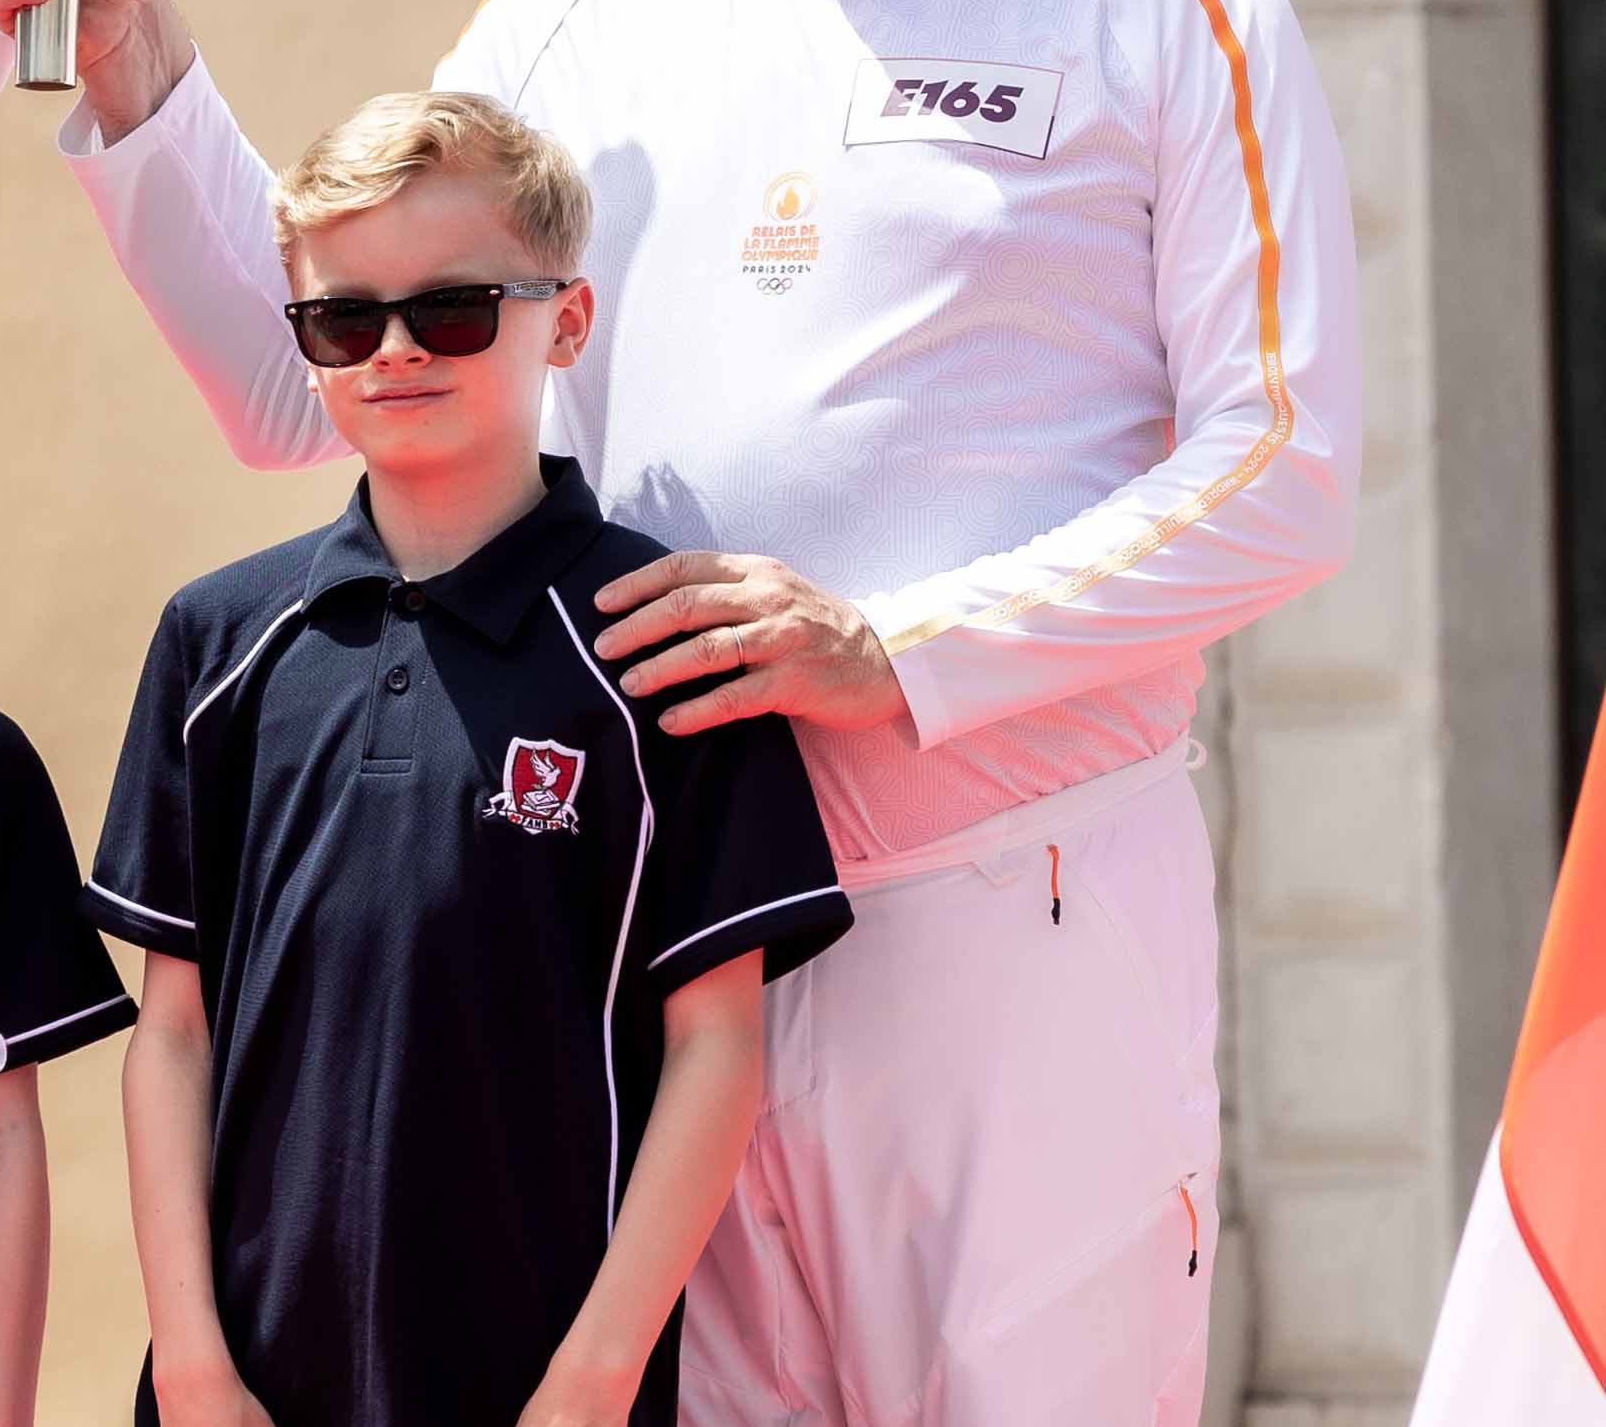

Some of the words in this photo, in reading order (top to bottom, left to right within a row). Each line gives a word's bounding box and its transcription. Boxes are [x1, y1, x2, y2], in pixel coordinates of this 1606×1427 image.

[880, 79, 1024, 123] E165
[751, 225, 797, 237] RELAIS
[800, 224, 818, 236] DE
[745, 237, 761, 250] LA
[763, 236, 819, 249] FLAMME
[741, 249, 819, 261] OLYMPIQUE
[742, 265, 776, 274] PARIS
[780, 264, 811, 274] 2024
